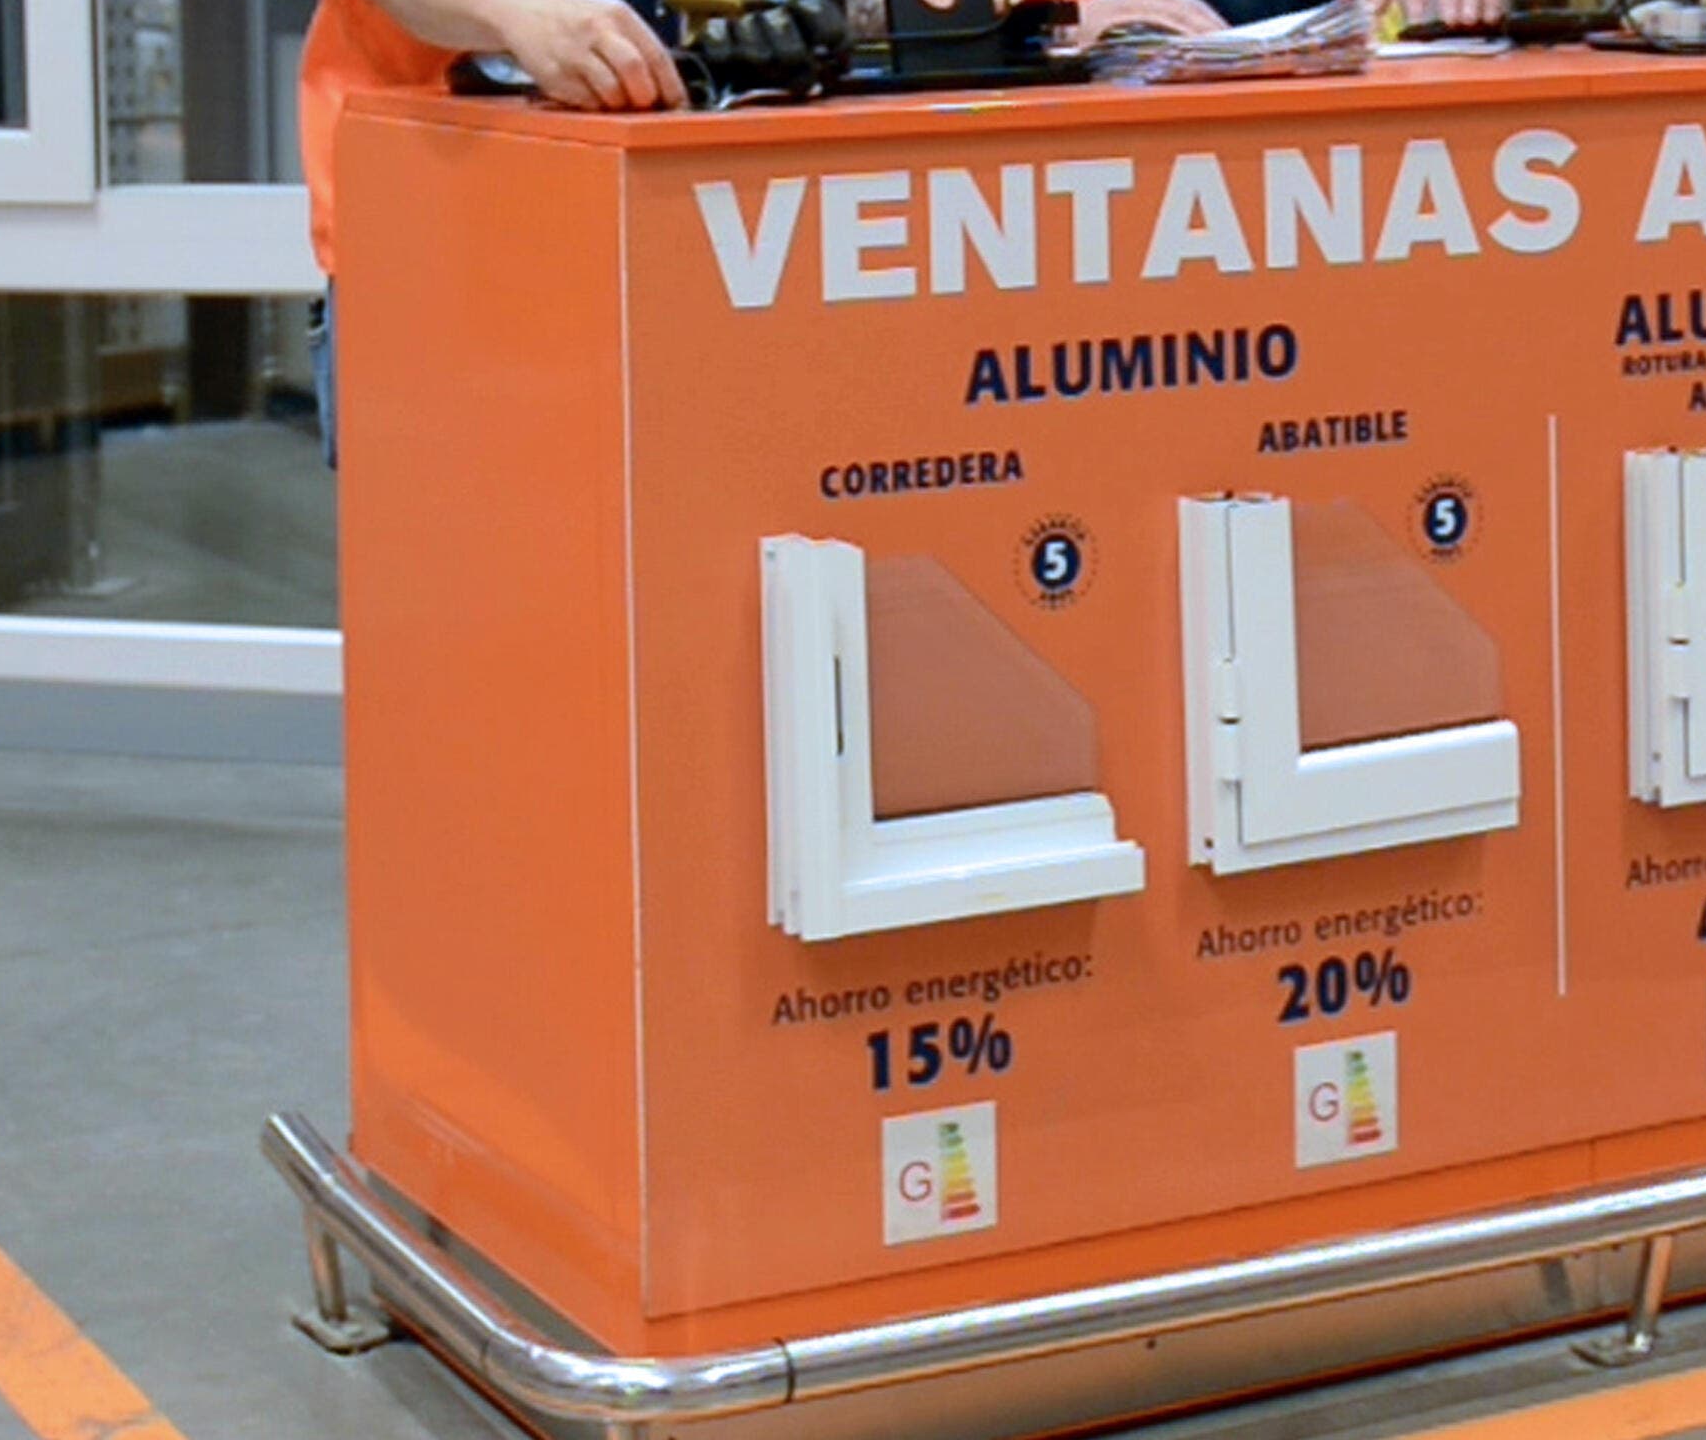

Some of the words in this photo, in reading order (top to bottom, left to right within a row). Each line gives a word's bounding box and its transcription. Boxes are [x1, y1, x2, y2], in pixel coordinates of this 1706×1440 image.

[694, 129, 1582, 309] VENTANAS
[965, 324, 1298, 405] ALUMINIO
[1257, 410, 1408, 453] ABATIBLE
[820, 450, 1024, 500] CORREDERA
[1433, 496, 1456, 536] 5
[1043, 539, 1068, 581] 5
[1196, 918, 1303, 959] Ahorro
[1314, 889, 1484, 943] energético:
[772, 984, 894, 1025] Ahorro
[904, 951, 1093, 1007] energético:
[1277, 949, 1411, 1023] 20%
[866, 1014, 1013, 1091] 15%
[1308, 1081, 1340, 1122] G
[899, 1160, 933, 1202] G
